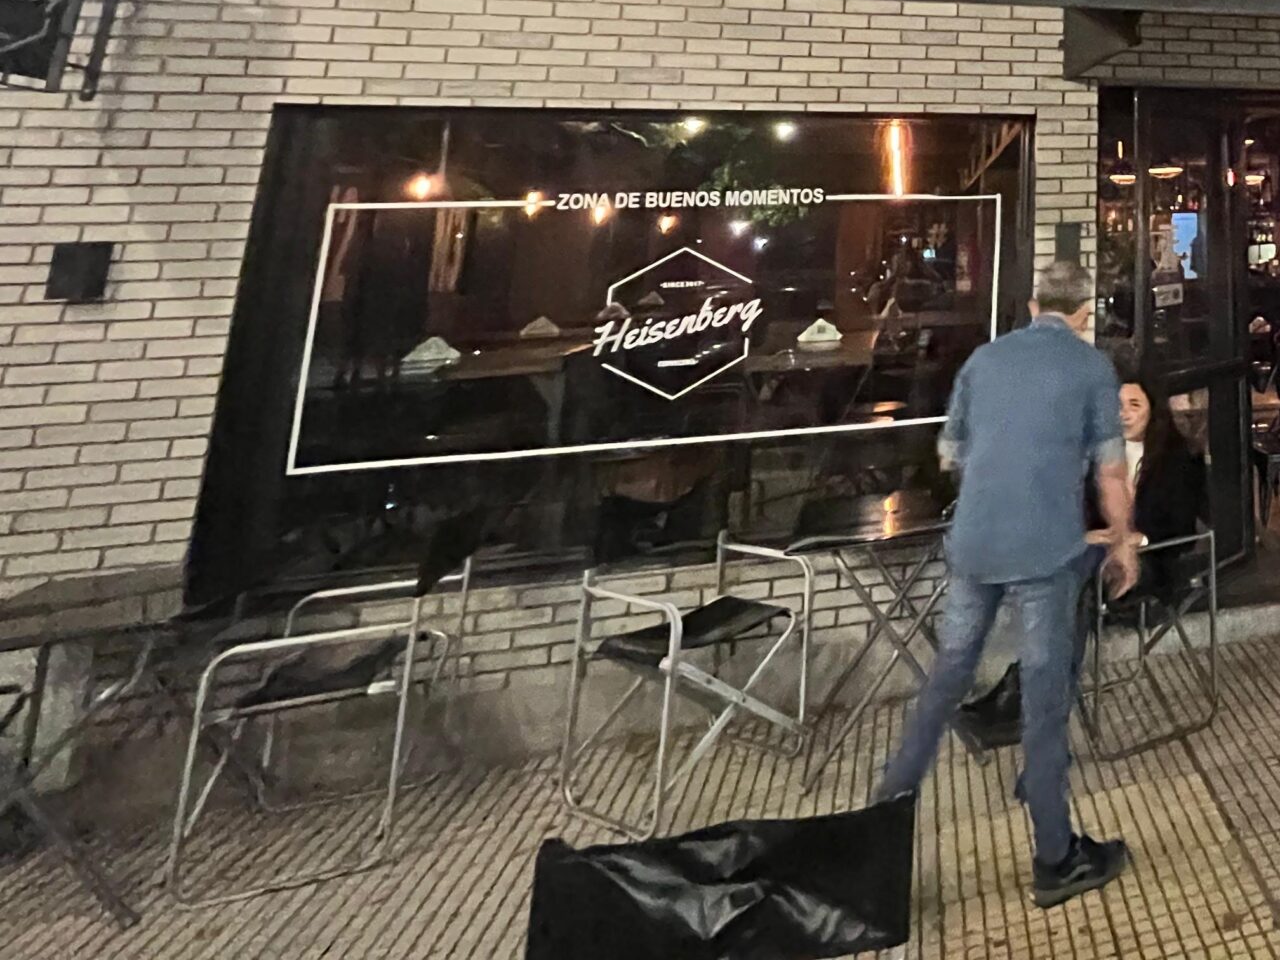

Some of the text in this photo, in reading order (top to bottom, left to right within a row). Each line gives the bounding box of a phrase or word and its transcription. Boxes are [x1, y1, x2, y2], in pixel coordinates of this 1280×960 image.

[556, 188, 825, 210] ZONA DE BUENOS MOMENTOS
[592, 296, 764, 357] Heisenberg
